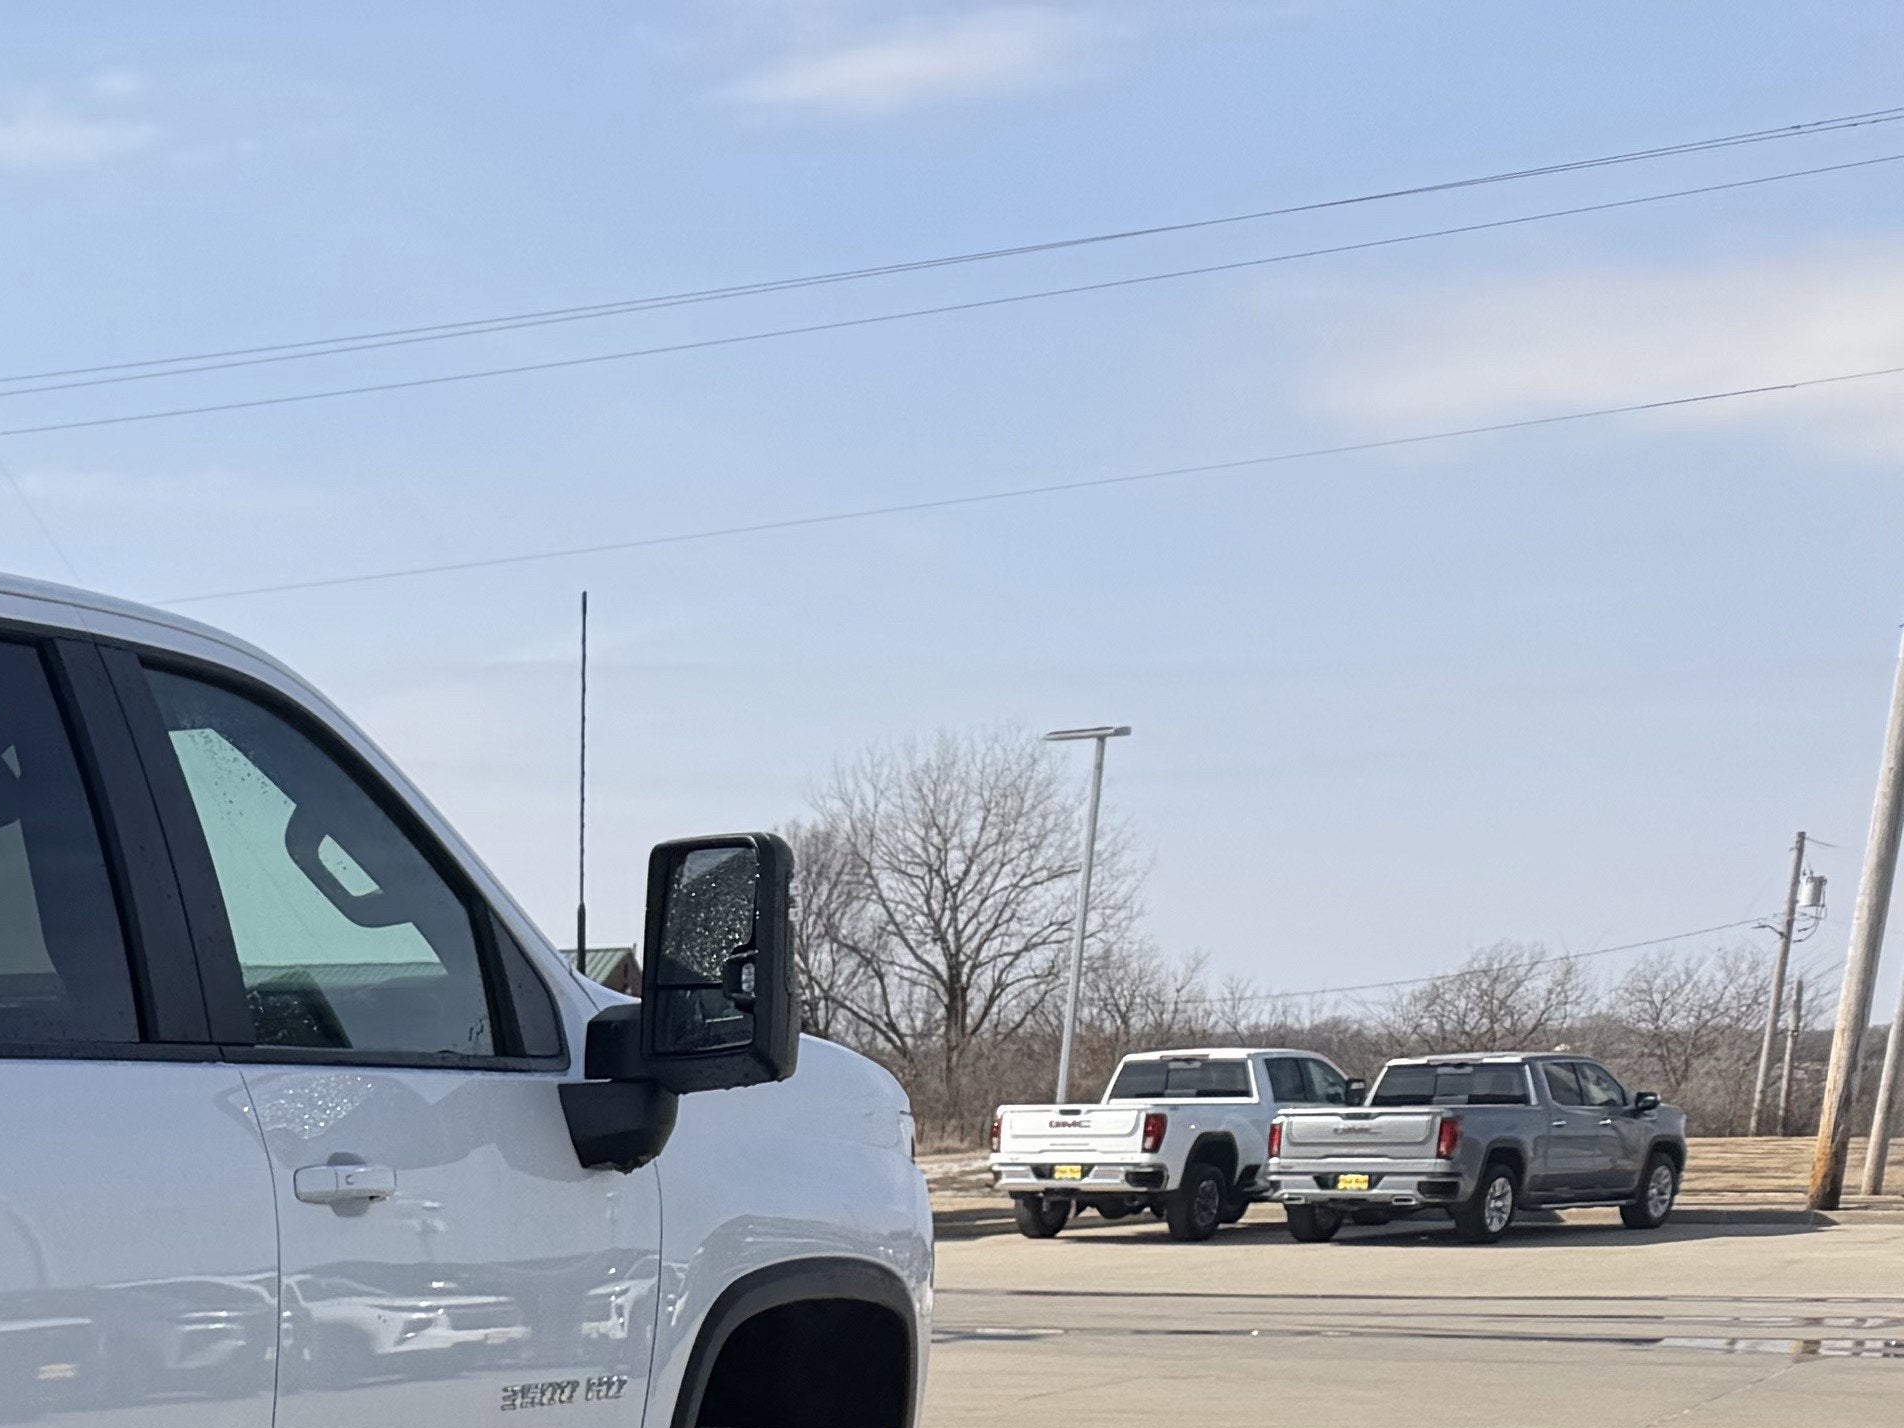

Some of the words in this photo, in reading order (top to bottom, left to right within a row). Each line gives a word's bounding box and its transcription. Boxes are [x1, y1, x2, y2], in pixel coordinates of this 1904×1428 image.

[1048, 1119, 1092, 1129] GMC
[500, 1380, 580, 1411] 3500
[585, 1376, 628, 1401] HD
